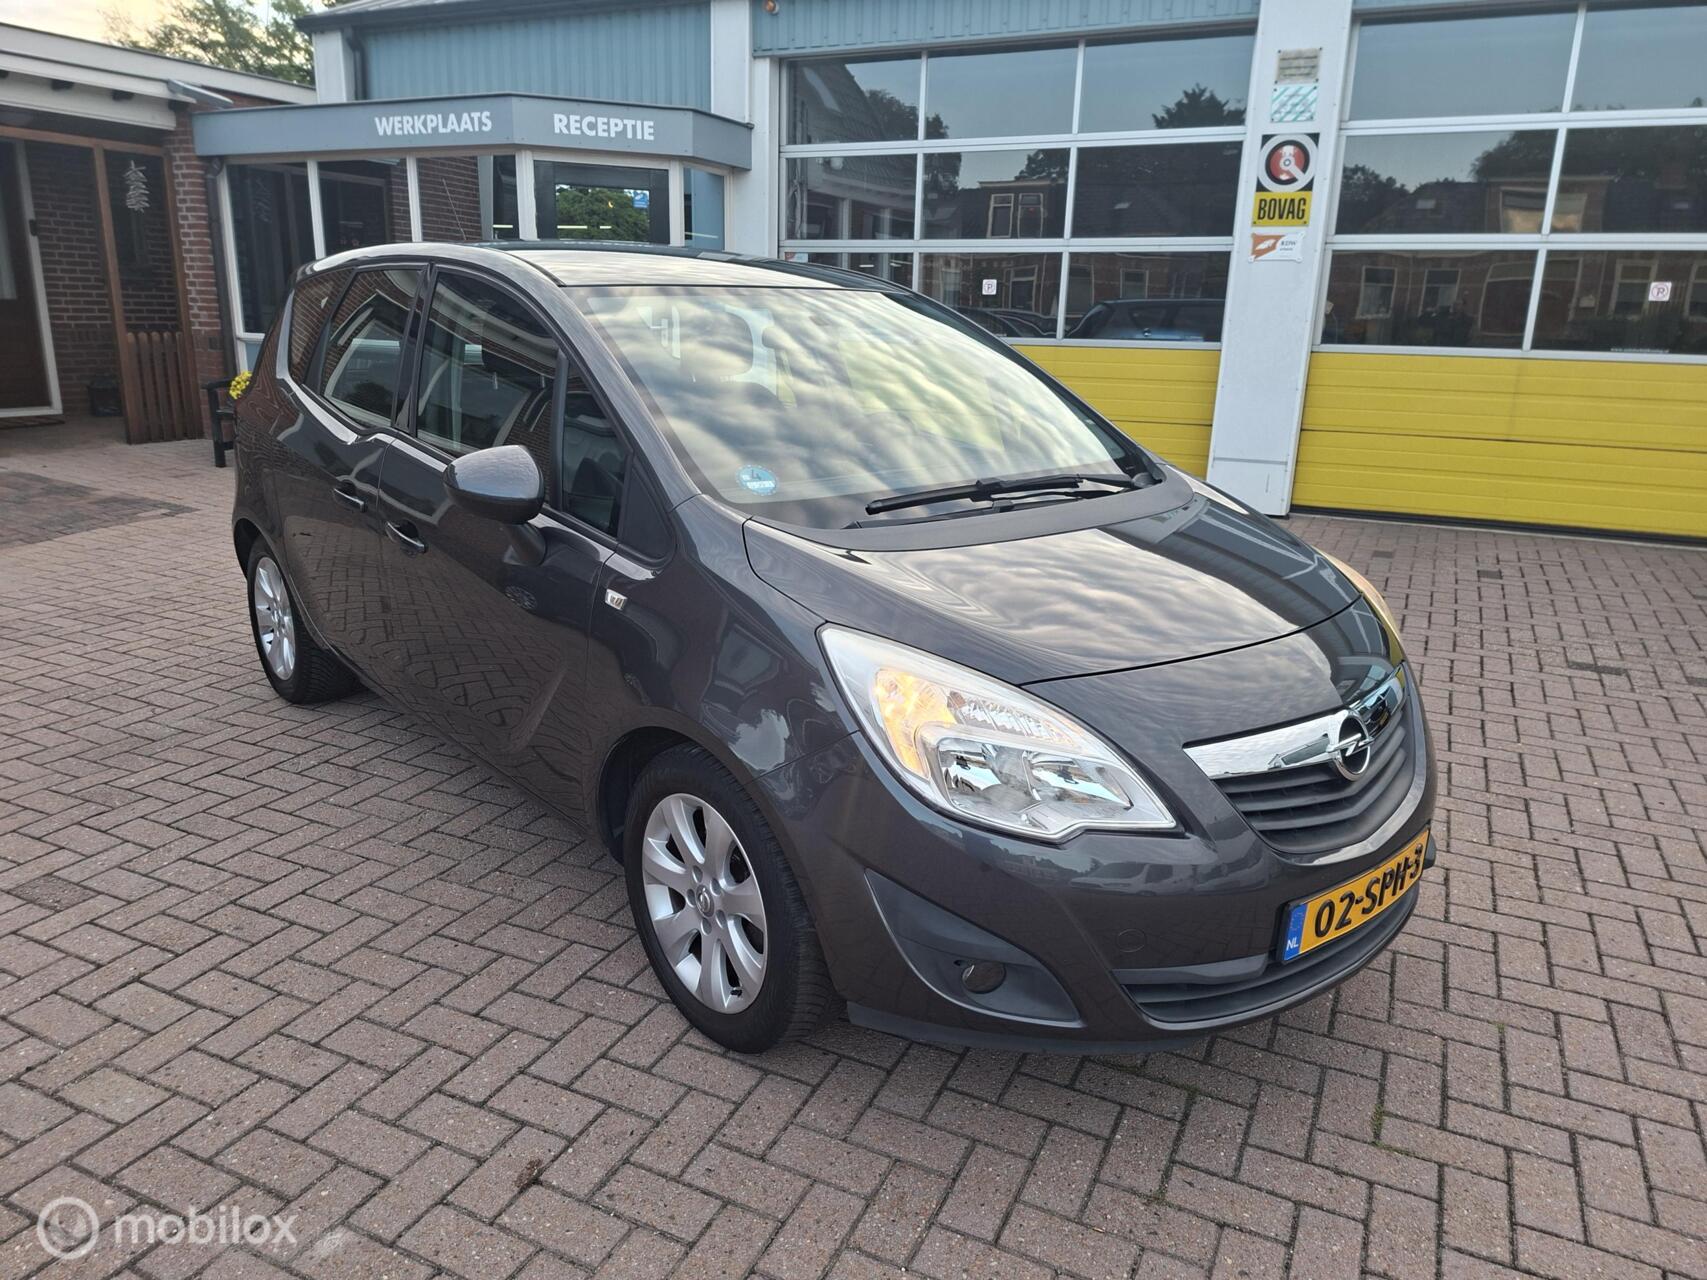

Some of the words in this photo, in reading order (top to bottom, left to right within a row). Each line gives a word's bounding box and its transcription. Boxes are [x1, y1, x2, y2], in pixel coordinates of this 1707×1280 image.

[374, 111, 493, 136] WERKPLAATS
[553, 113, 655, 141] RECEPTIE
[1257, 197, 1307, 220] BOVAG
[1314, 843, 1424, 938] 02-SPH-3
[1286, 937, 1299, 951] NL
